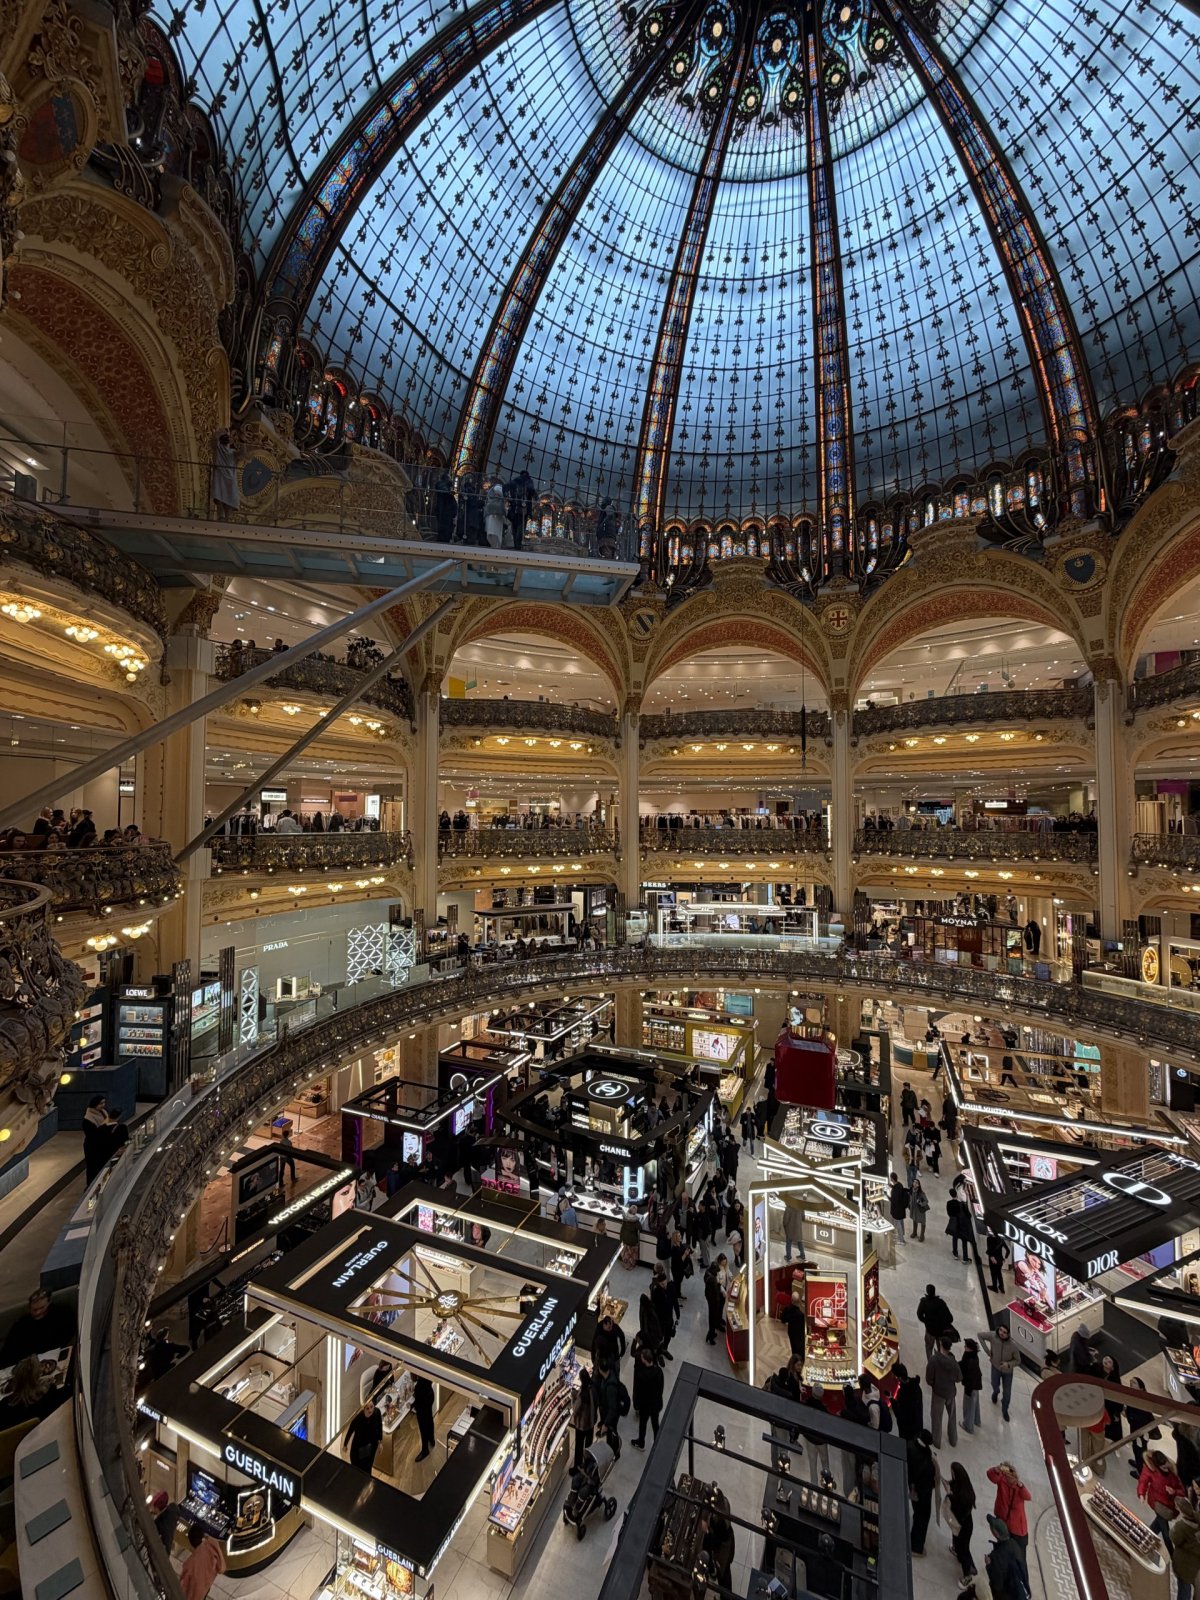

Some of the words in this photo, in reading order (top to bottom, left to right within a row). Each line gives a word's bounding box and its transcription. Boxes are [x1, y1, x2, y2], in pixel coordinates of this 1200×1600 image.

[941, 917, 979, 927] MOYNAT
[263, 941, 288, 952] PRADA
[125, 988, 148, 997] LOEWE
[371, 1114, 389, 1122] CHANEL
[599, 1144, 632, 1158] CHANEL
[267, 1192, 315, 1225] VICTORIA
[312, 1168, 353, 1198] BECKHAM
[1003, 1219, 1057, 1266] DIOR
[1013, 1212, 1069, 1245] DIOR
[332, 1240, 389, 1288] GUERLAIN
[1087, 1249, 1120, 1279] DIOR
[512, 1297, 559, 1358] GUERLAIN
[538, 1320, 554, 1341] PARIS
[539, 1311, 578, 1381] GUERLAIN
[224, 1444, 295, 1498] GUERLAIN
[376, 1544, 415, 1573] GUERLAIN
